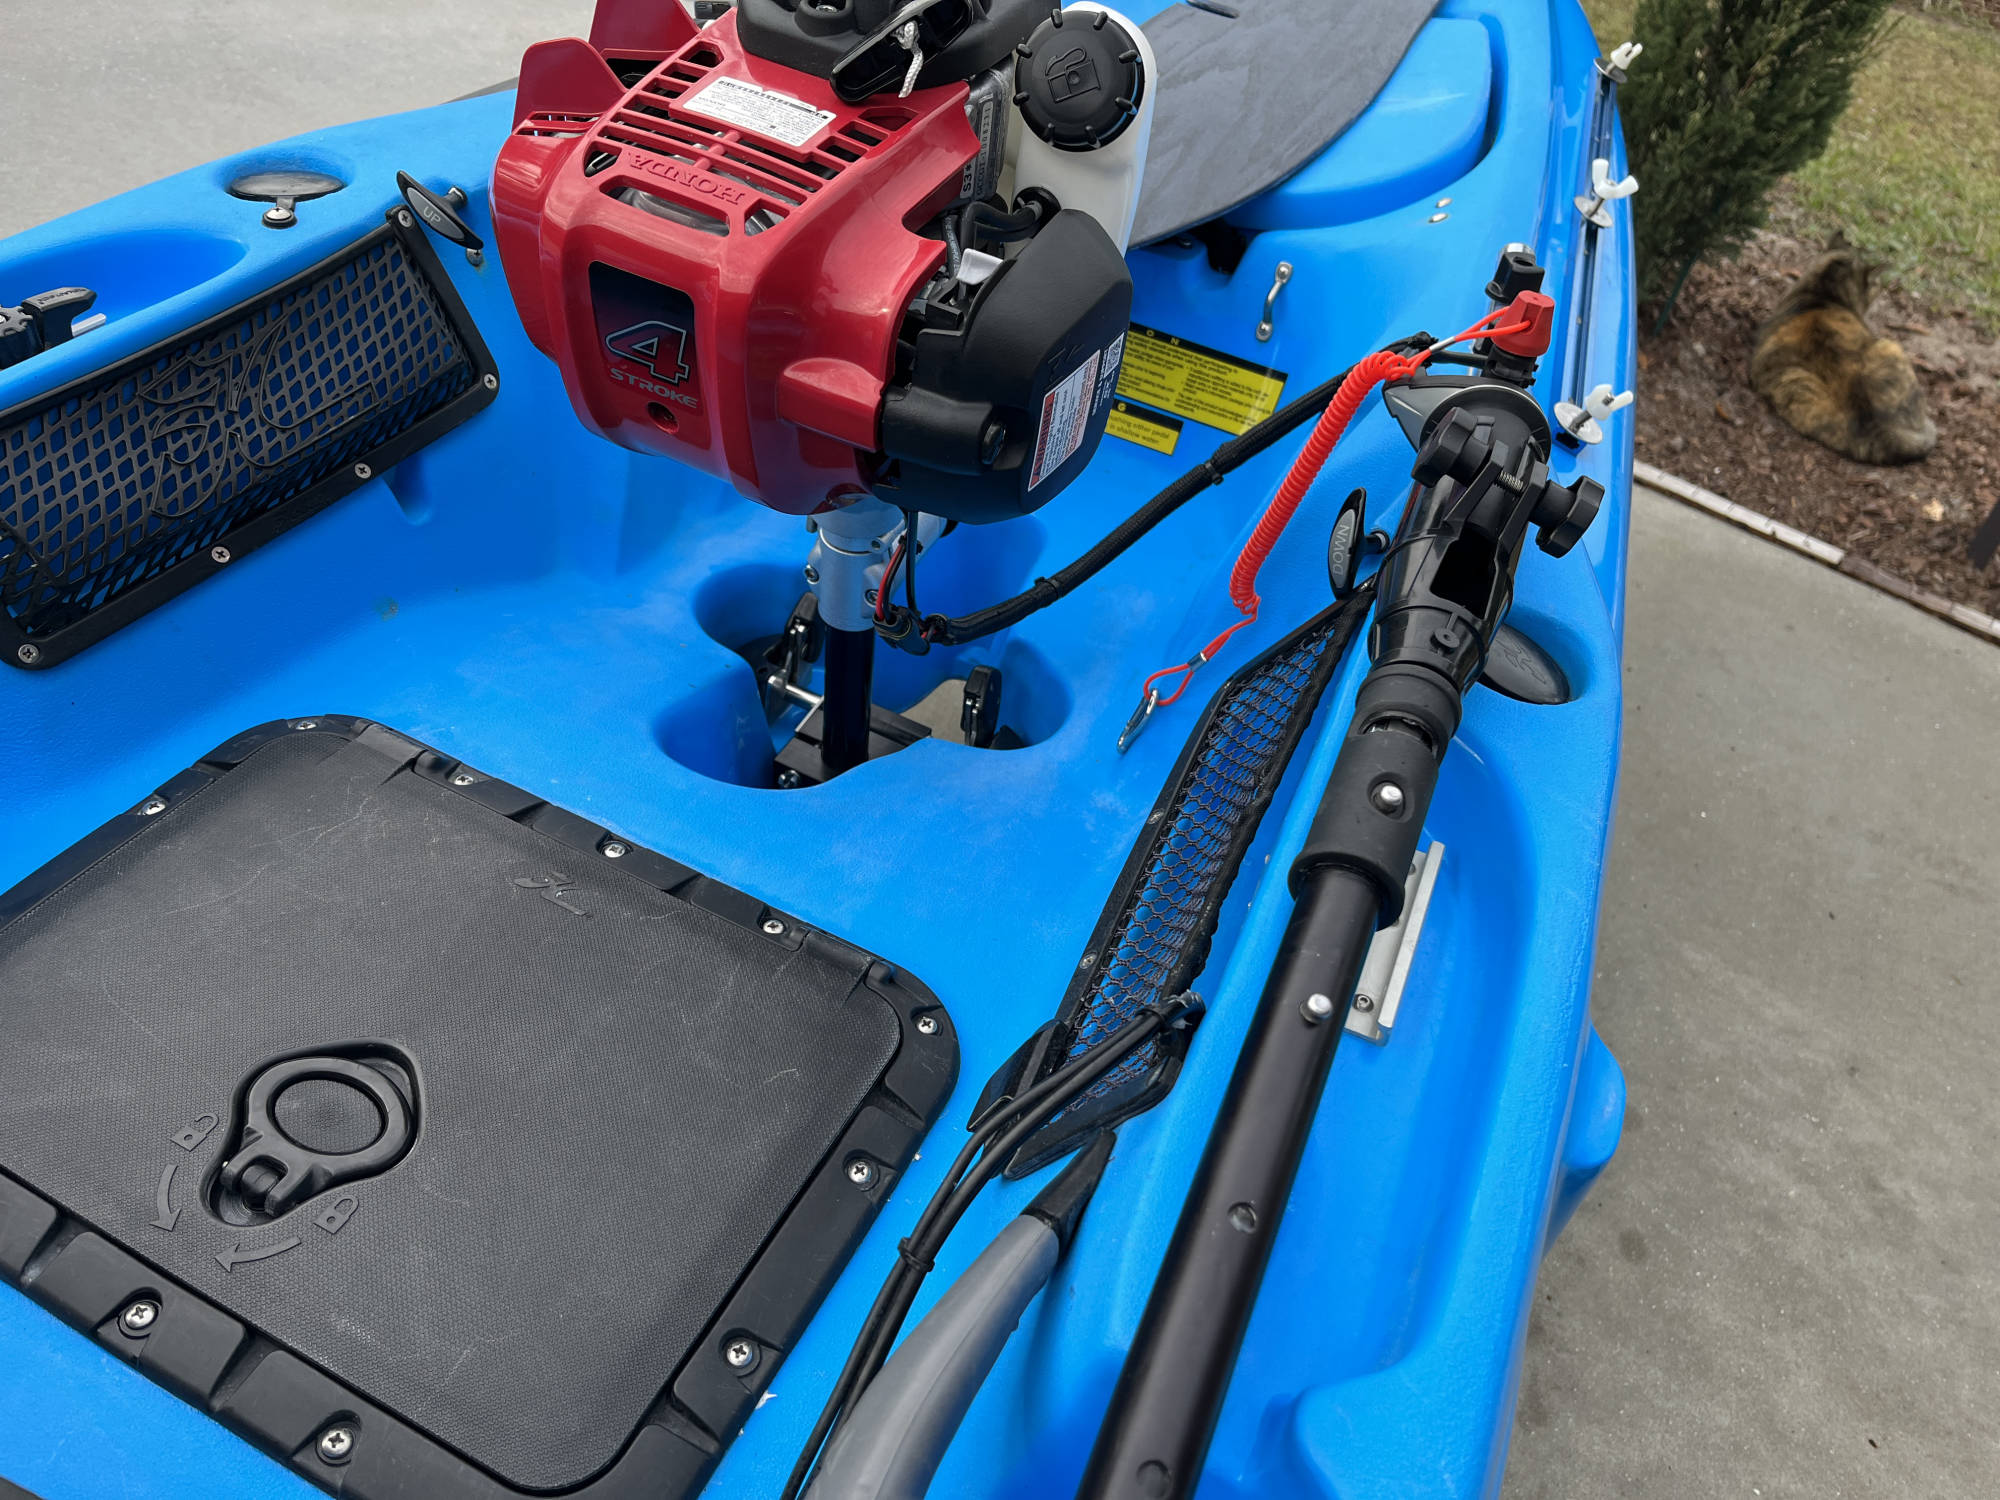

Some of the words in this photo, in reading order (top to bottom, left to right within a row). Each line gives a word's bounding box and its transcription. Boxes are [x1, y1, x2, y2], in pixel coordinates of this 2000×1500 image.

[628, 152, 745, 205] HONDA
[423, 206, 441, 223] UP
[605, 320, 690, 385] 4
[610, 367, 698, 409] STROKE
[1332, 524, 1351, 576] DOWN
